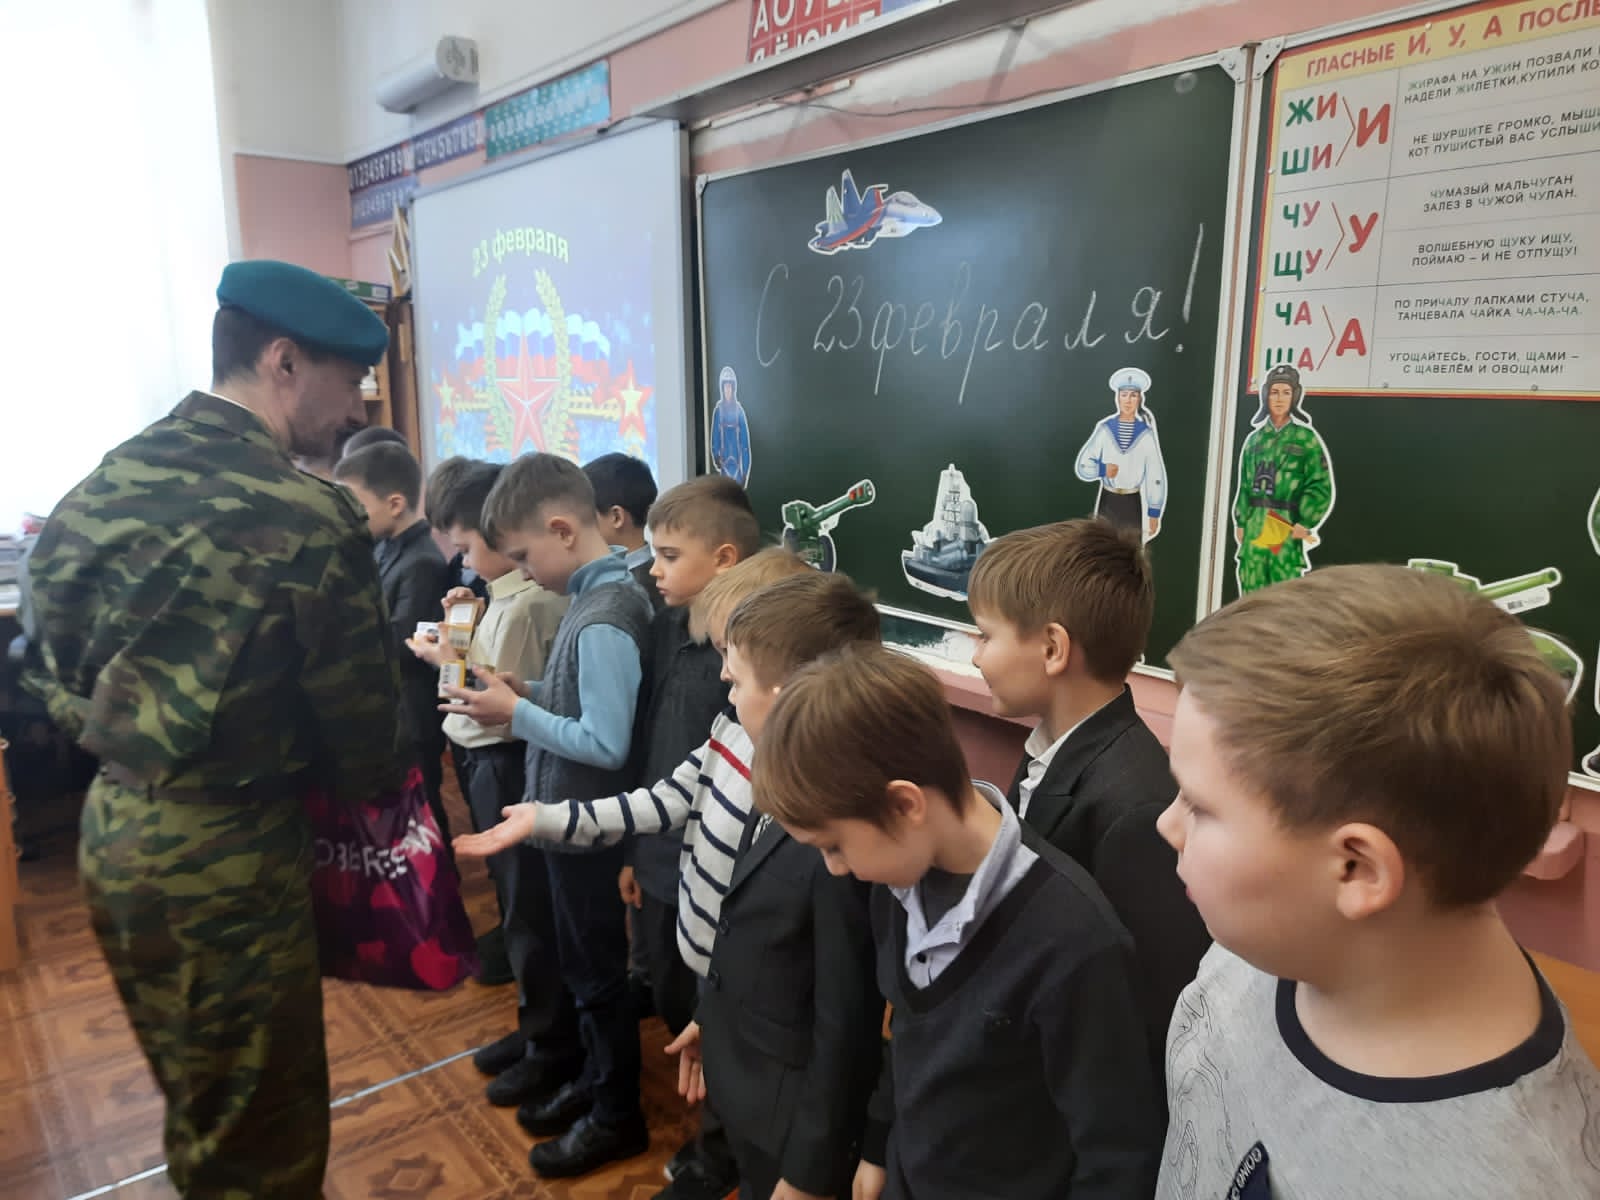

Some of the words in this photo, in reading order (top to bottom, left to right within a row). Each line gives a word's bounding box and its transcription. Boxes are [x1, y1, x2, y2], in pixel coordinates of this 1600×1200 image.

[1306, 42, 1395, 78] ГЛАСНЫЕ
[1483, 15, 1502, 40] А
[1408, 74, 1456, 91] ЖИРАФА
[1461, 69, 1477, 81] НА
[1483, 61, 1521, 77] УЖИН
[1526, 47, 1592, 68] ПОЗВАЛИ
[1286, 91, 1338, 127] ЖИ
[1404, 88, 1451, 104] НАДЕЛИ
[1356, 103, 1391, 148] И
[1413, 134, 1428, 144] НЕ
[1432, 124, 1493, 142] ШУРШИТЕ
[1408, 147, 1430, 158] КОТ
[1434, 135, 1504, 153] ПУШИСТЫЙ
[1509, 131, 1535, 144] ВАС
[1281, 143, 1332, 176] ШИ
[1430, 183, 1489, 198] ЧУМАЗЫЙ
[1494, 175, 1573, 192] МАЛЬЧУГАН
[1283, 200, 1320, 228] ЧУ
[1423, 200, 1460, 212] ЗАЛЕЗ
[1465, 199, 1473, 208] В
[1478, 193, 1524, 207] ЧУЖОЙ
[1529, 189, 1577, 201] ЧУЛАН.
[492, 227, 569, 264] февраля
[1349, 212, 1379, 253] У
[1418, 239, 1495, 254] ВОЛШЕБНУЮ
[1500, 235, 1536, 248] ЩУКУ
[1273, 248, 1323, 281] ЩУ
[1412, 254, 1465, 267] ПОЙМАЮ
[1481, 252, 1489, 262] И
[1494, 250, 1511, 261] НЕ
[1516, 246, 1577, 259] ОТПУЩУ!
[1275, 300, 1312, 326] ЧА
[1394, 300, 1410, 309] ПО
[1415, 296, 1470, 308] ПРИЧАЛУ
[1474, 295, 1535, 305] ЛАПКАМИ
[1540, 292, 1590, 303] СТУЧА,
[1397, 309, 1465, 321] ТАНЦЕВАЛА
[1470, 306, 1512, 318] ЧАЙКА
[756, 263, 788, 367] С
[1335, 318, 1367, 357] А
[1389, 351, 1471, 362] УГОЩАЙТЕСЬ,
[1475, 351, 1520, 362] ГОСТИ,
[1526, 351, 1566, 362] ЩАМИ
[1403, 364, 1410, 374] С
[1415, 363, 1473, 375] ЩАВЕЛЁМ
[1478, 364, 1486, 374] И
[1491, 364, 1563, 376] ОВОЩАМИ!
